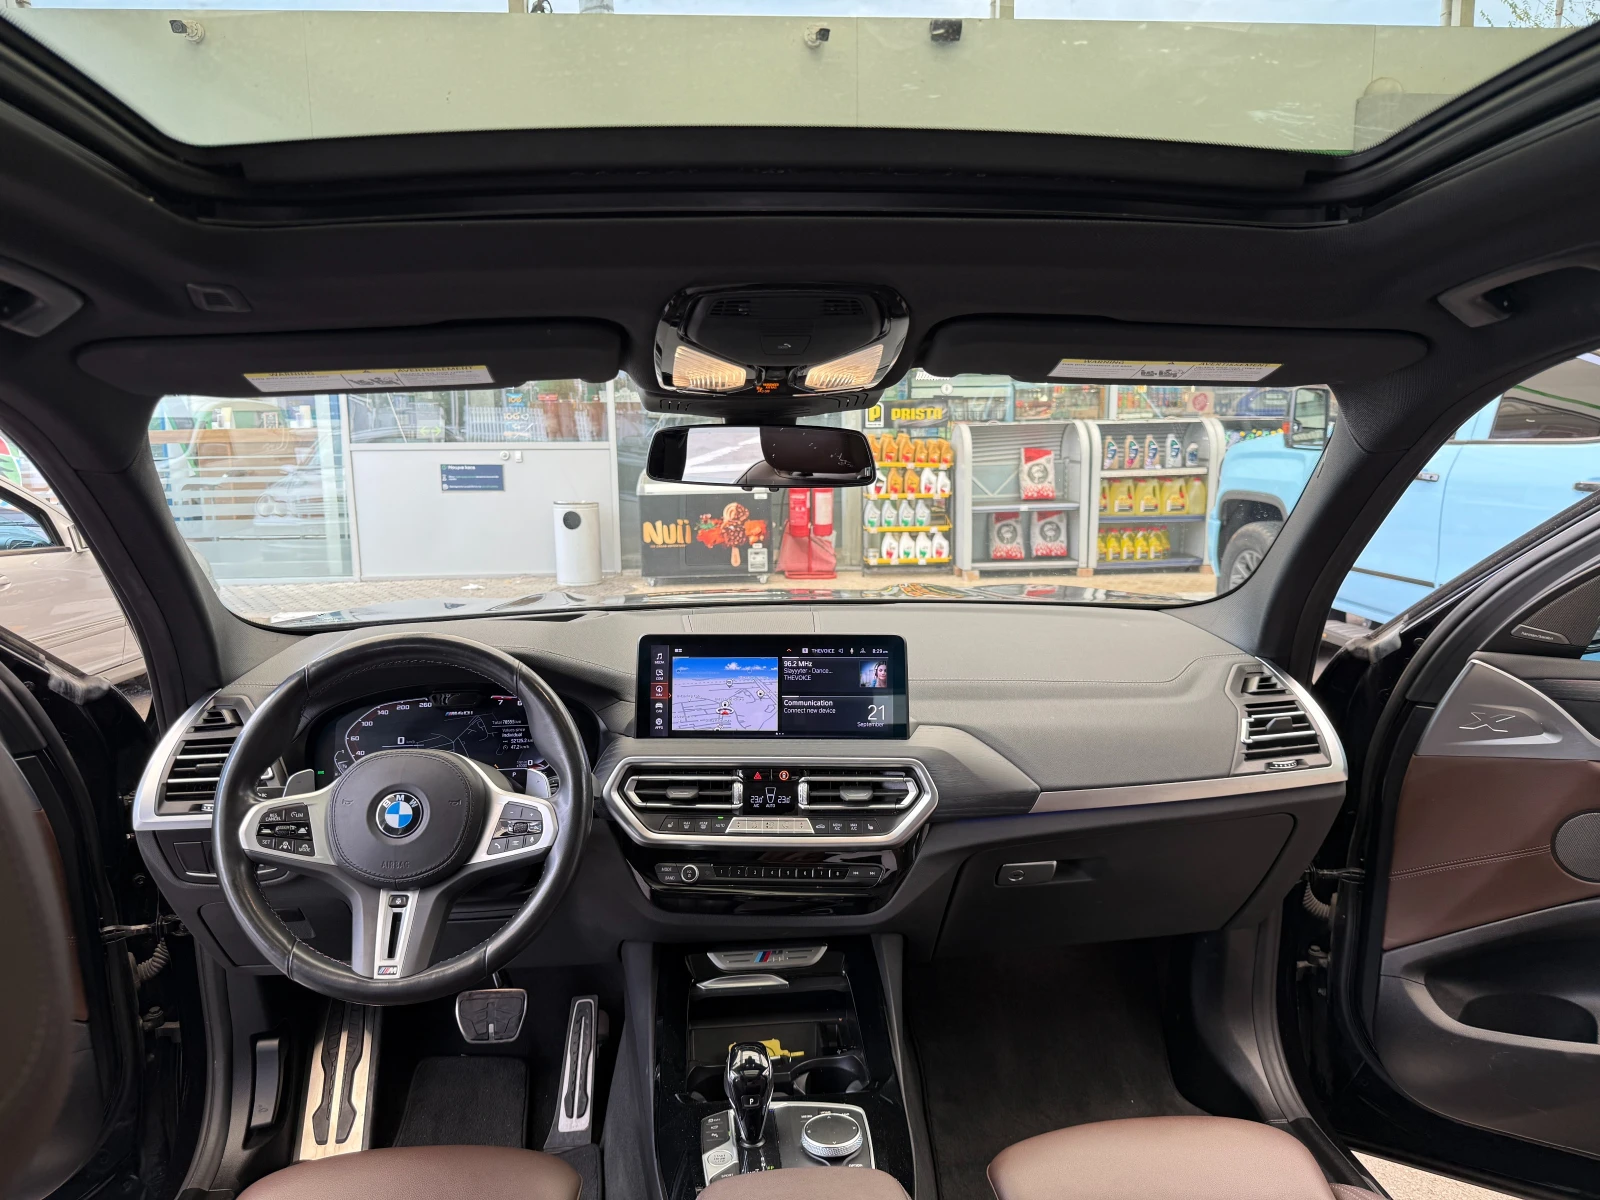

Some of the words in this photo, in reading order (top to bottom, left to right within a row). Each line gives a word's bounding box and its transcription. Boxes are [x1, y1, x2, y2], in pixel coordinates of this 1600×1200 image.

[891, 407, 943, 421] PRISTA
[643, 519, 692, 545] Nuii
[867, 704, 886, 721] 21
[397, 736, 405, 745] 0
[382, 794, 418, 808] BMW
[381, 860, 410, 869] AIRBAG
